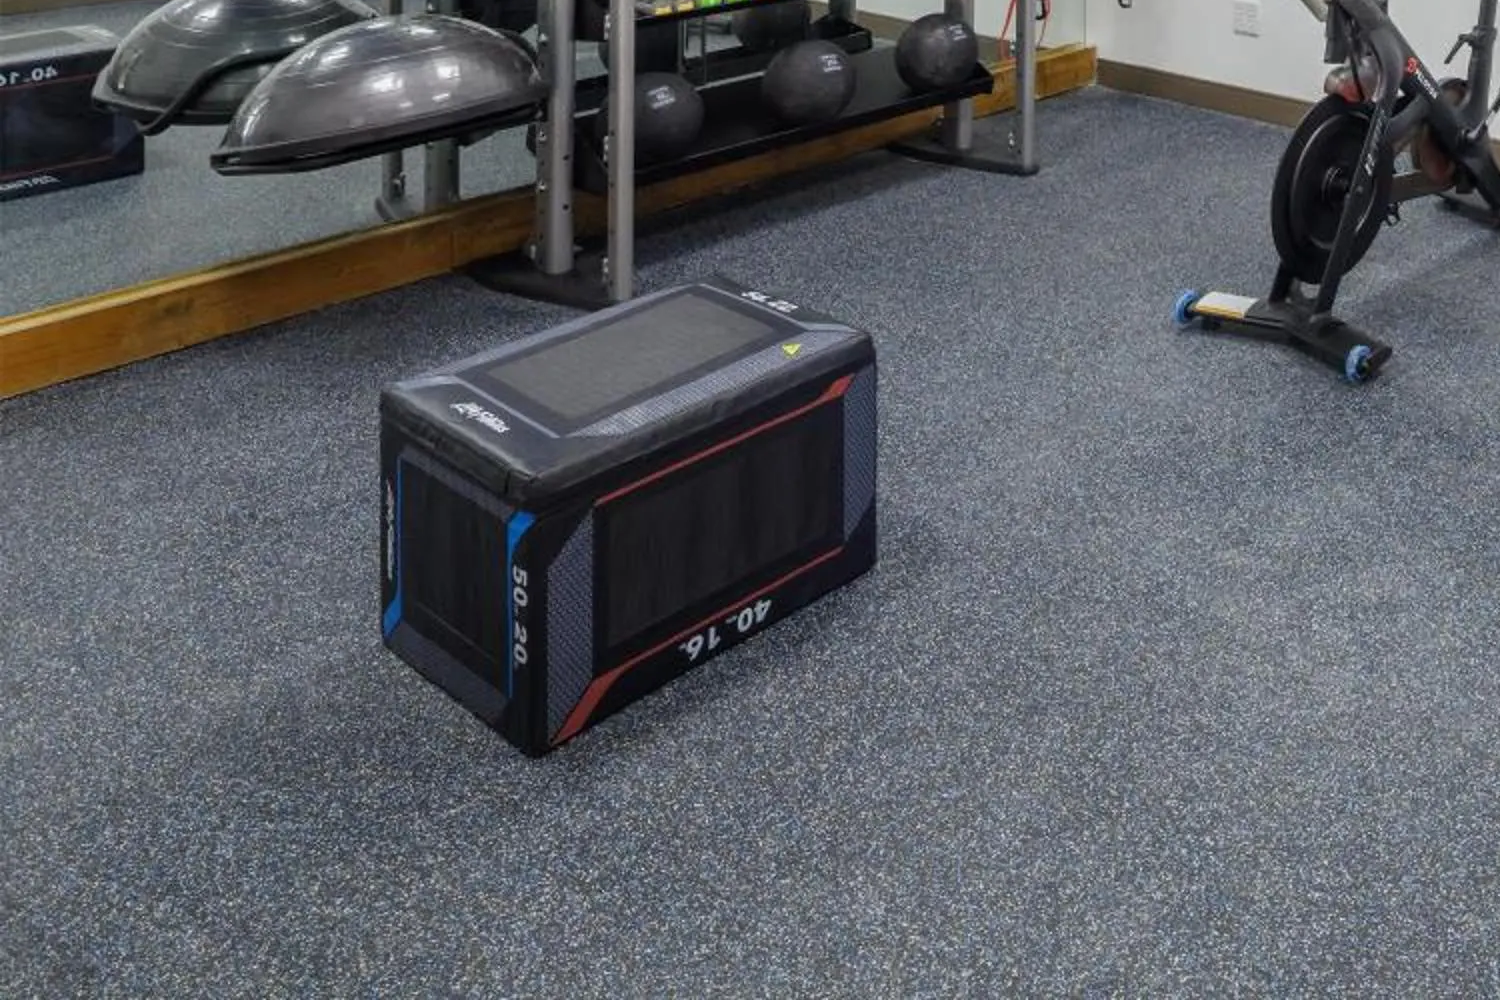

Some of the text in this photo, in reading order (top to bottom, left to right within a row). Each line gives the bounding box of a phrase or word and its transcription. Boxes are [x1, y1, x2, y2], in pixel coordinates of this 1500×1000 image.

[512, 564, 528, 665] 50 20
[686, 599, 772, 661] 40 16
